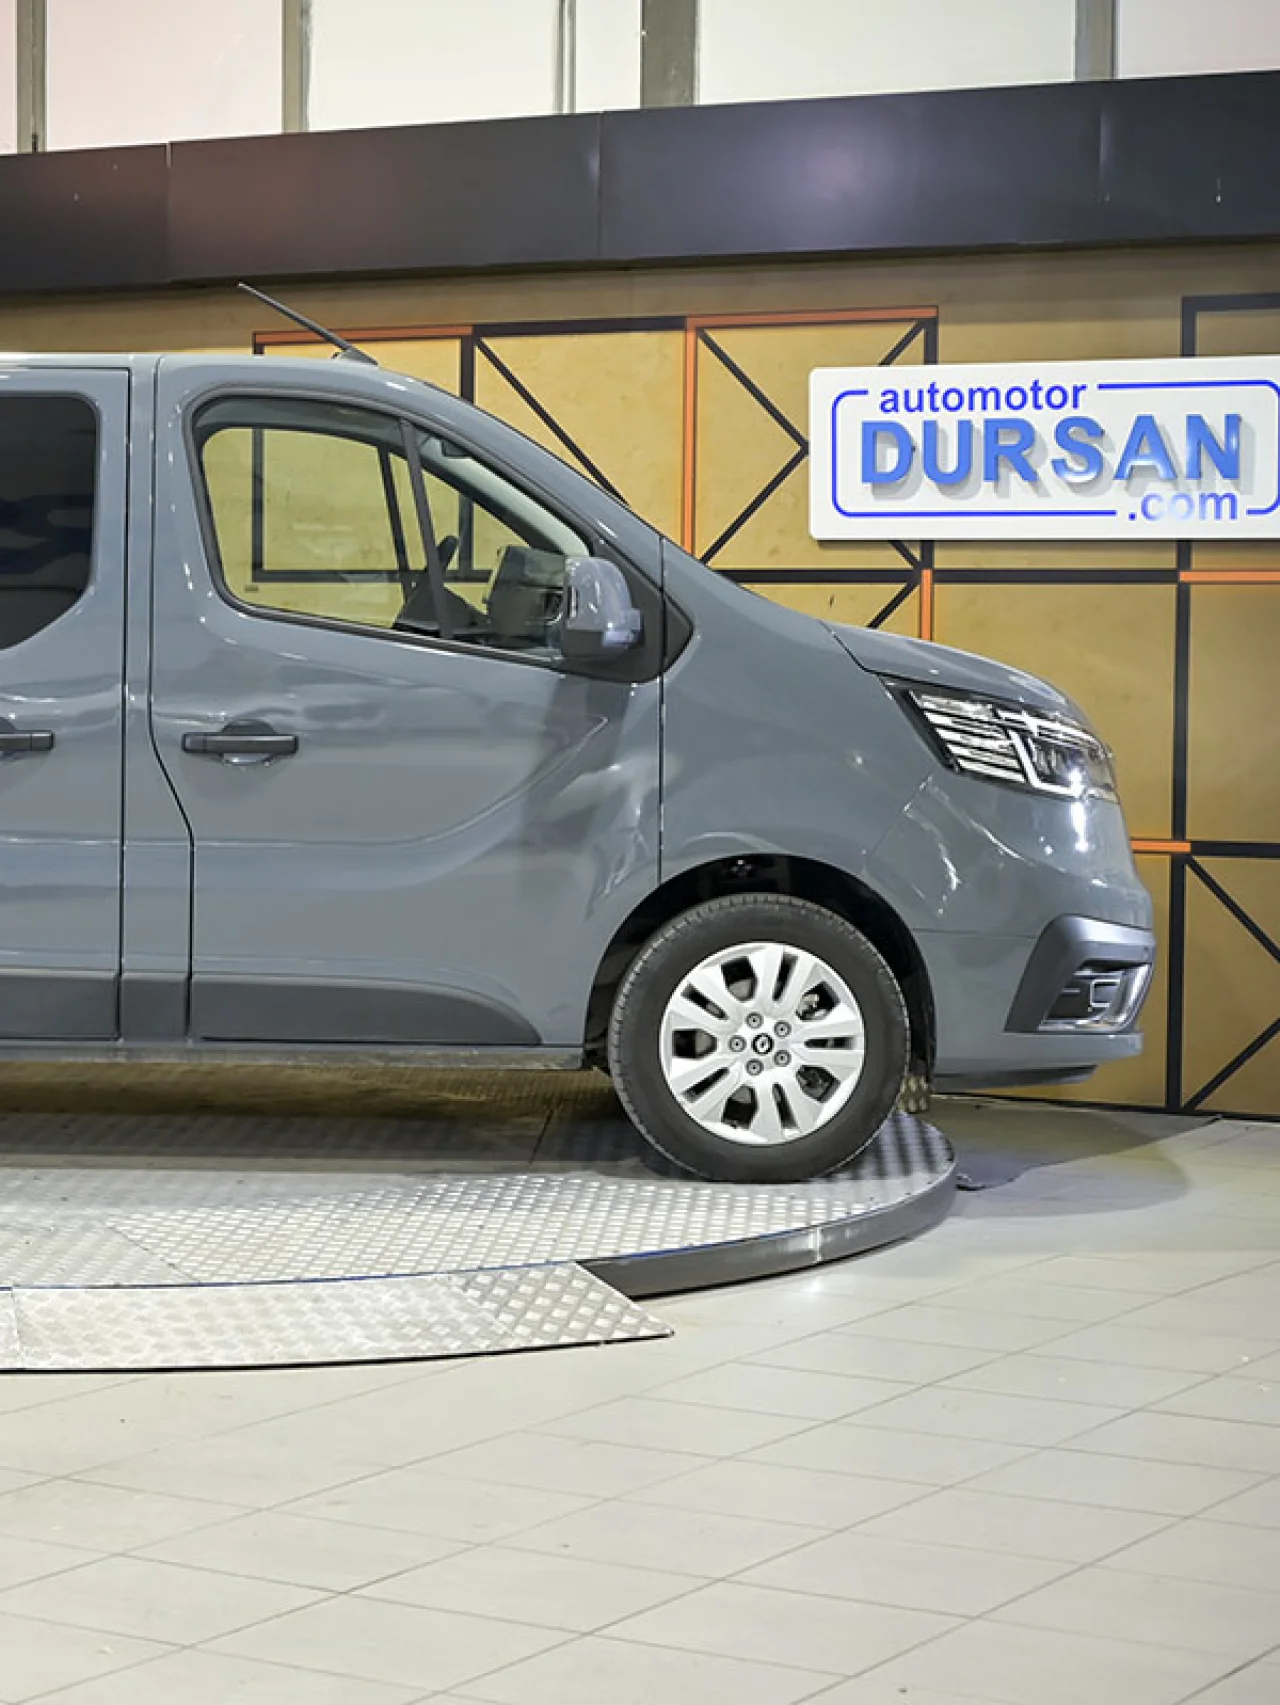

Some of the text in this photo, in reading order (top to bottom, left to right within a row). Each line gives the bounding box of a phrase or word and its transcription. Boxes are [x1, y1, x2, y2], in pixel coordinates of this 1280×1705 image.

[880, 379, 1087, 413] automotor
[861, 413, 1242, 485] DURSAN
[1128, 491, 1238, 521] .com
